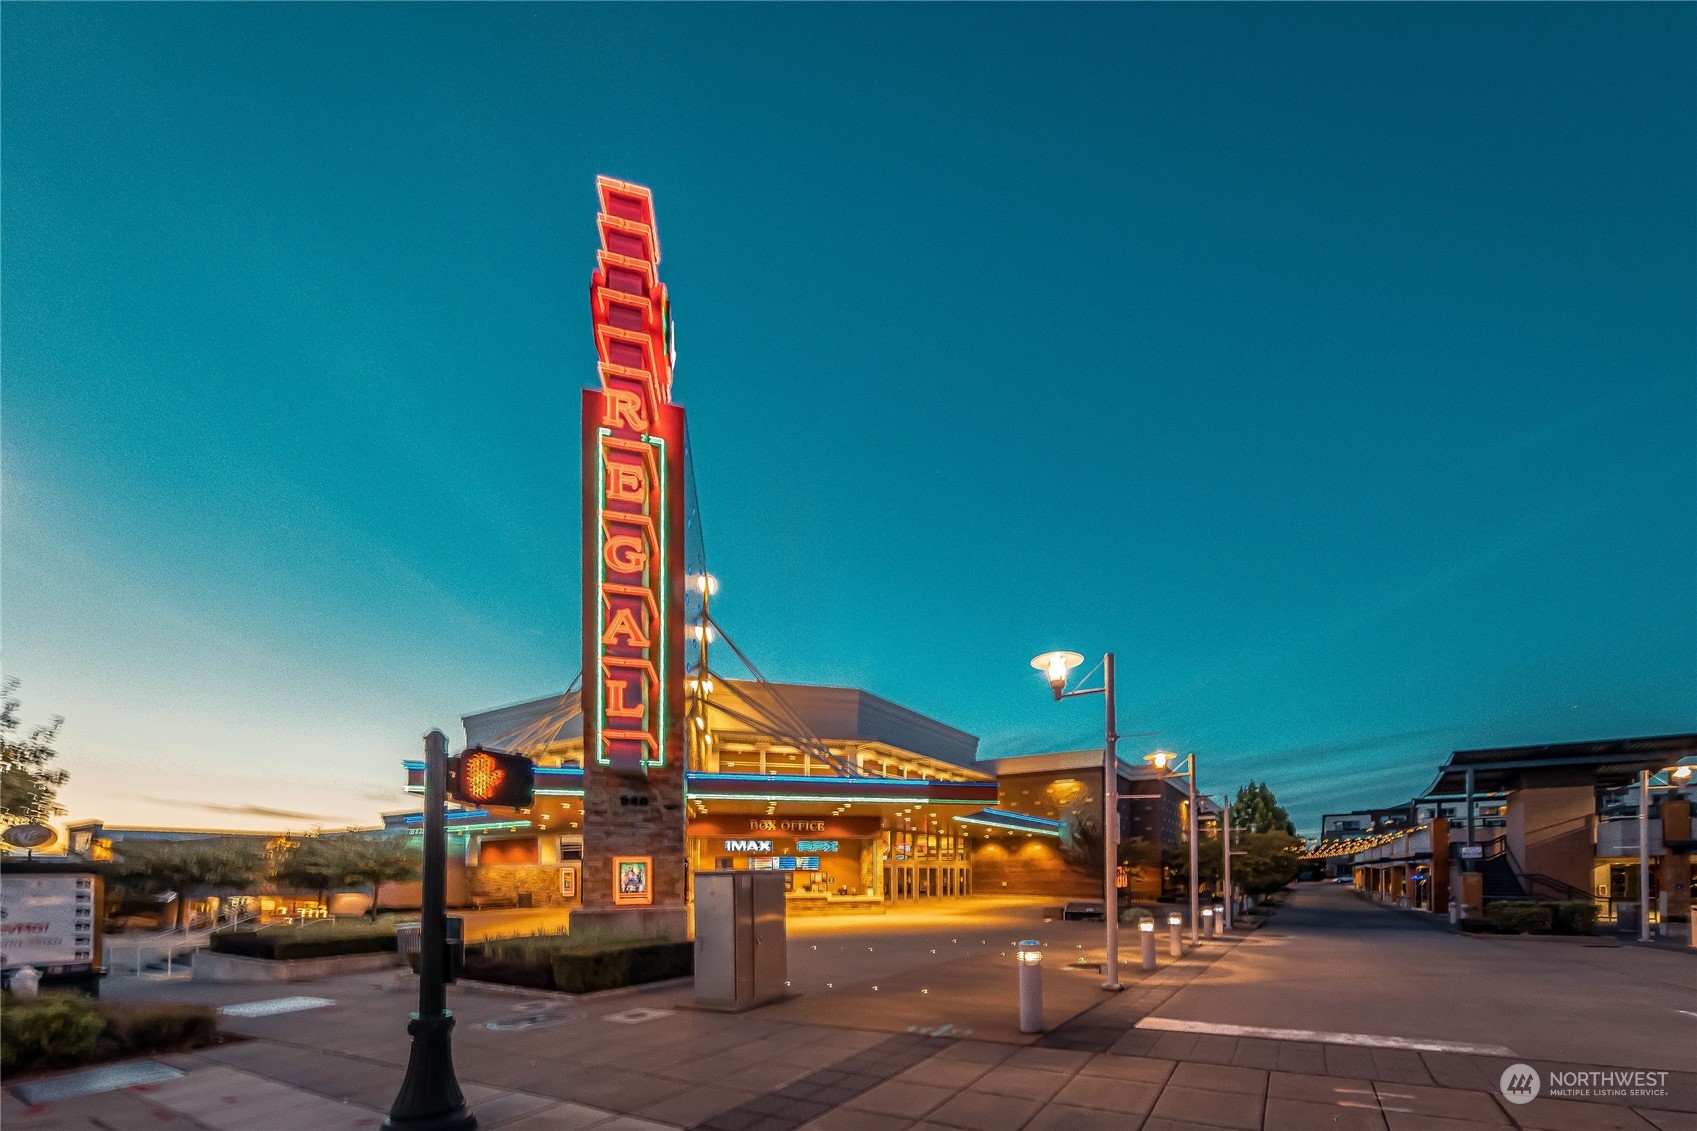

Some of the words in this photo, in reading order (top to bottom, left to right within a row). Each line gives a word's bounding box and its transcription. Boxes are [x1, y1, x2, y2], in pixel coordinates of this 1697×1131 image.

[602, 388, 650, 718] REGAL
[750, 820, 776, 831] BOX
[781, 820, 825, 832] OFFICE
[725, 840, 772, 852] IMAX
[796, 841, 838, 852] RPX
